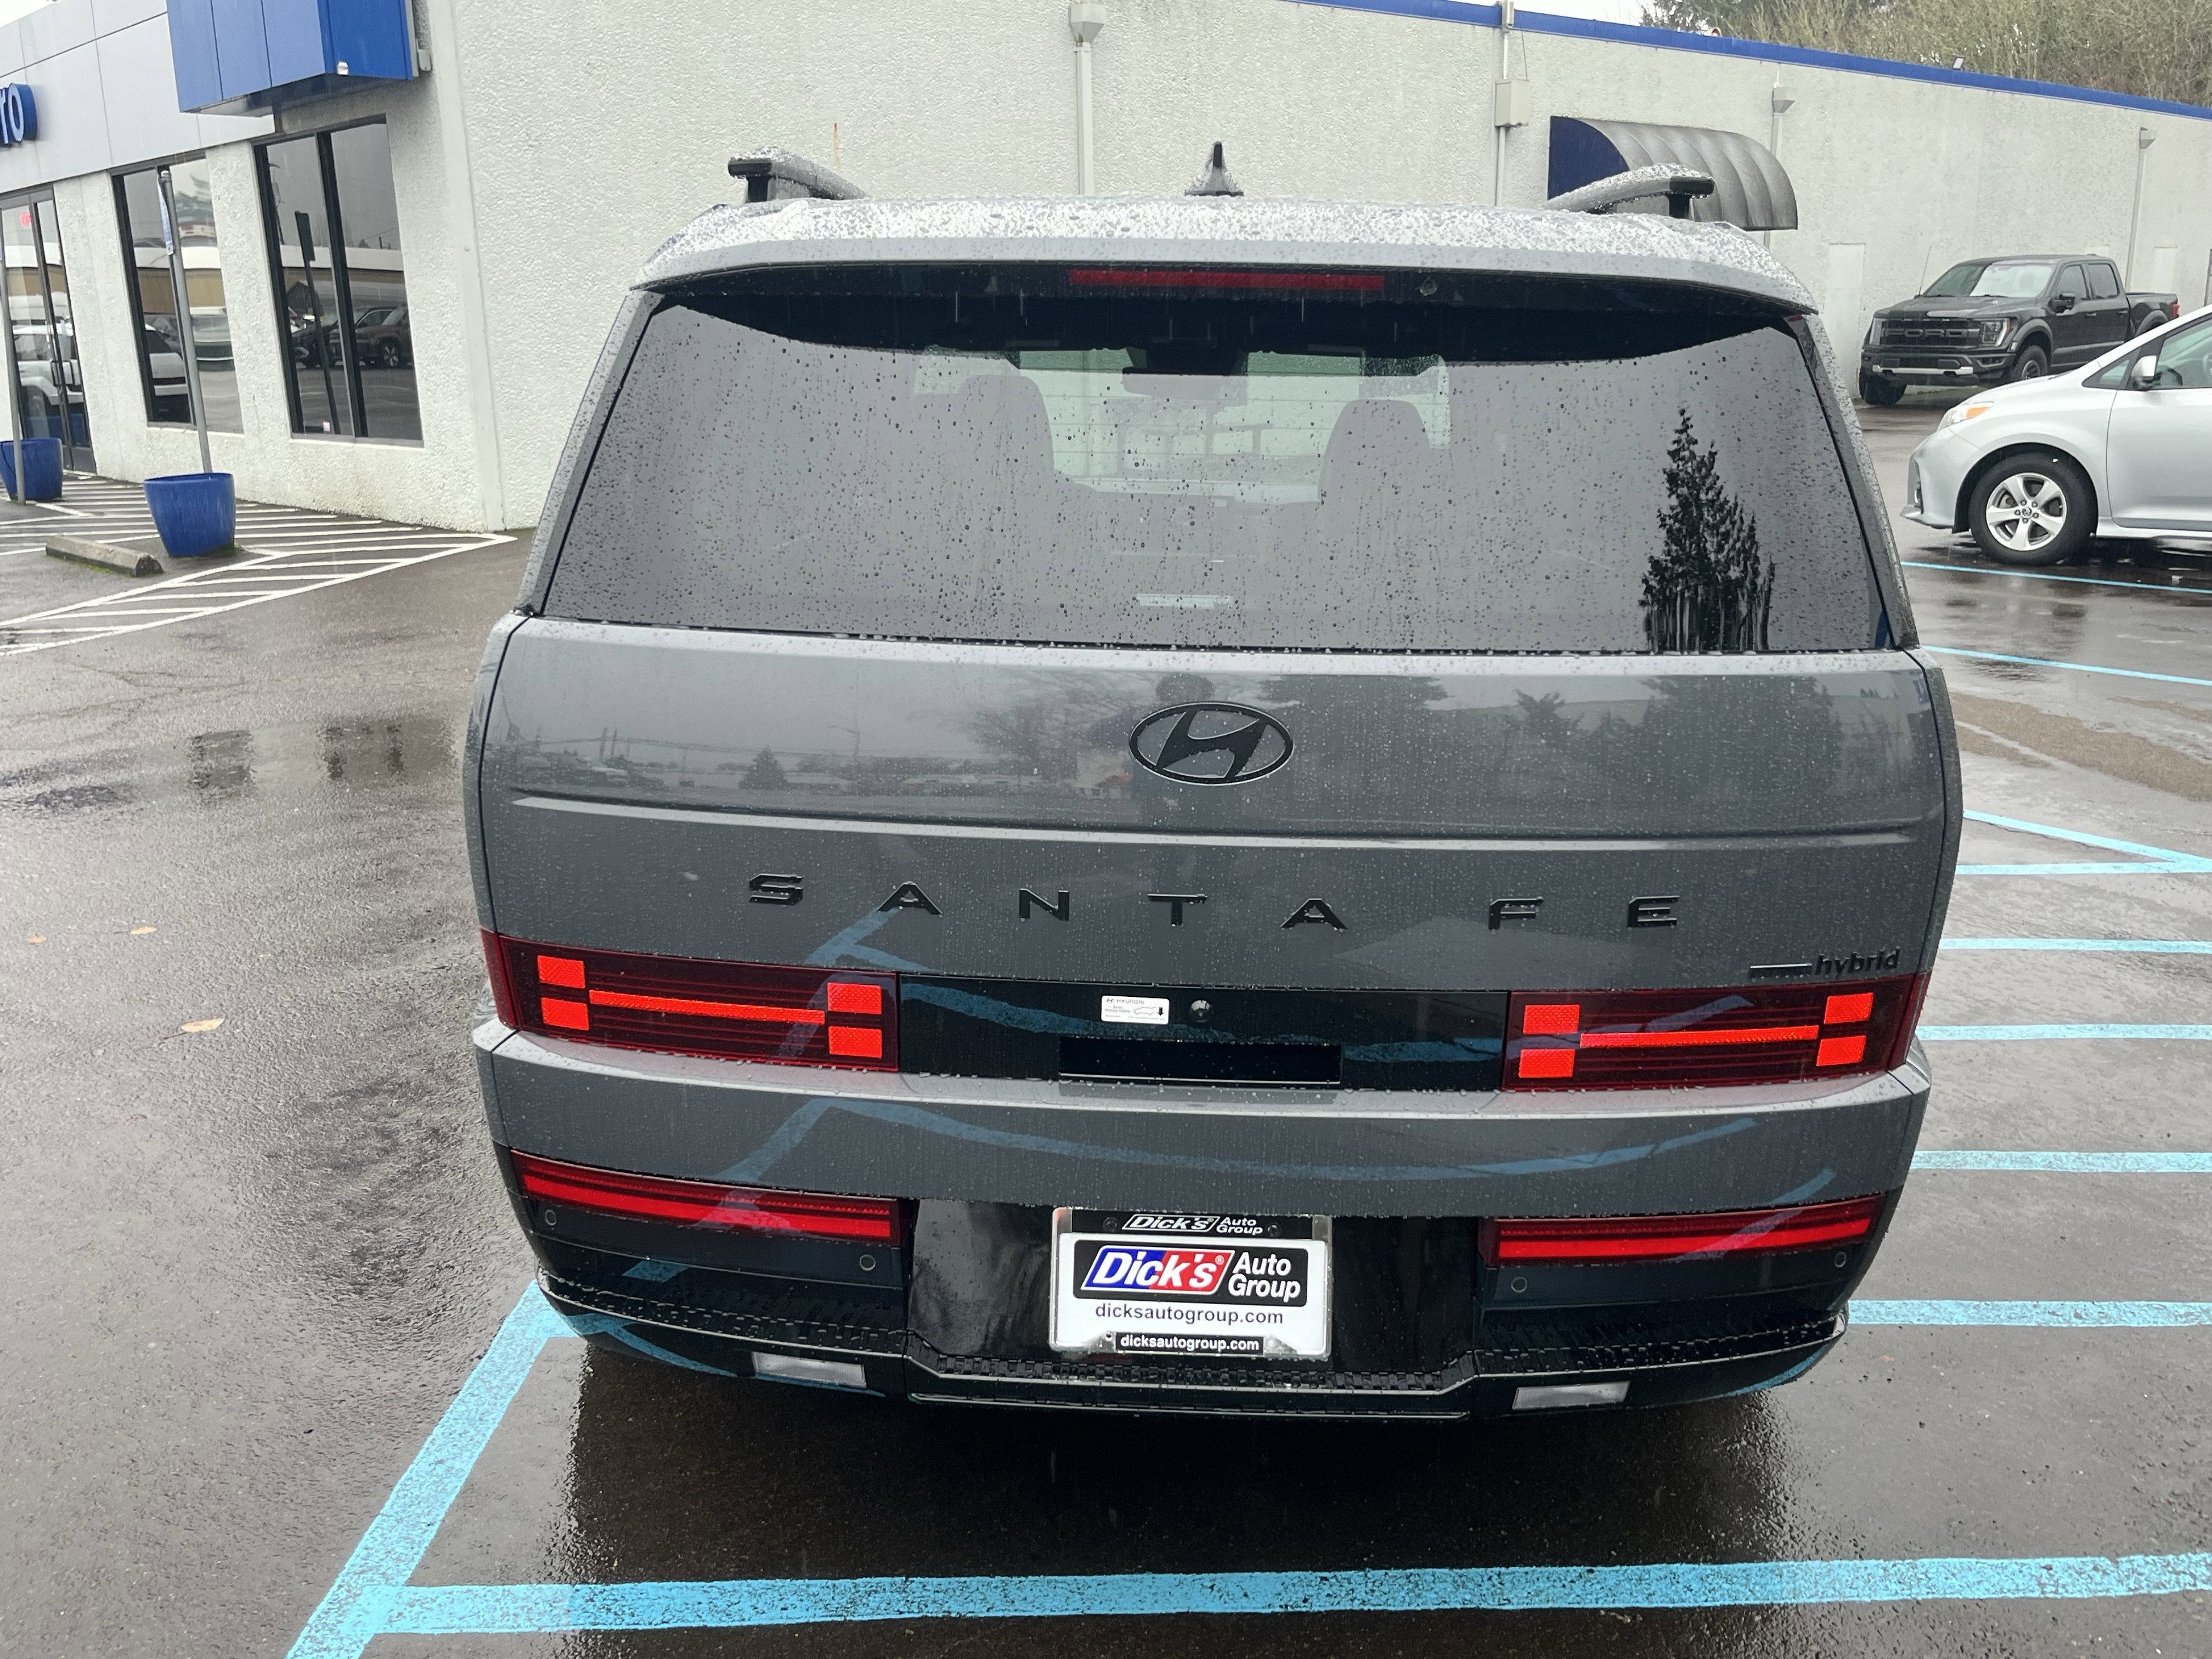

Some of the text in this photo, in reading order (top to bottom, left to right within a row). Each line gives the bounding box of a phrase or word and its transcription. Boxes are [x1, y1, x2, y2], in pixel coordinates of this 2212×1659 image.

[1884, 328, 1968, 338] FORD
[749, 873, 1679, 930] SANTA FE
[1815, 945, 1900, 979] hybrid
[1130, 1216, 1257, 1230] Dick's Auto
[1216, 1224, 1263, 1235] Group
[1092, 1251, 1291, 1288] Dick's Auto
[1228, 1273, 1301, 1302] Group
[1095, 1302, 1284, 1325] dicksautogroup.com
[1120, 1334, 1260, 1352] dicksautogroup.com
